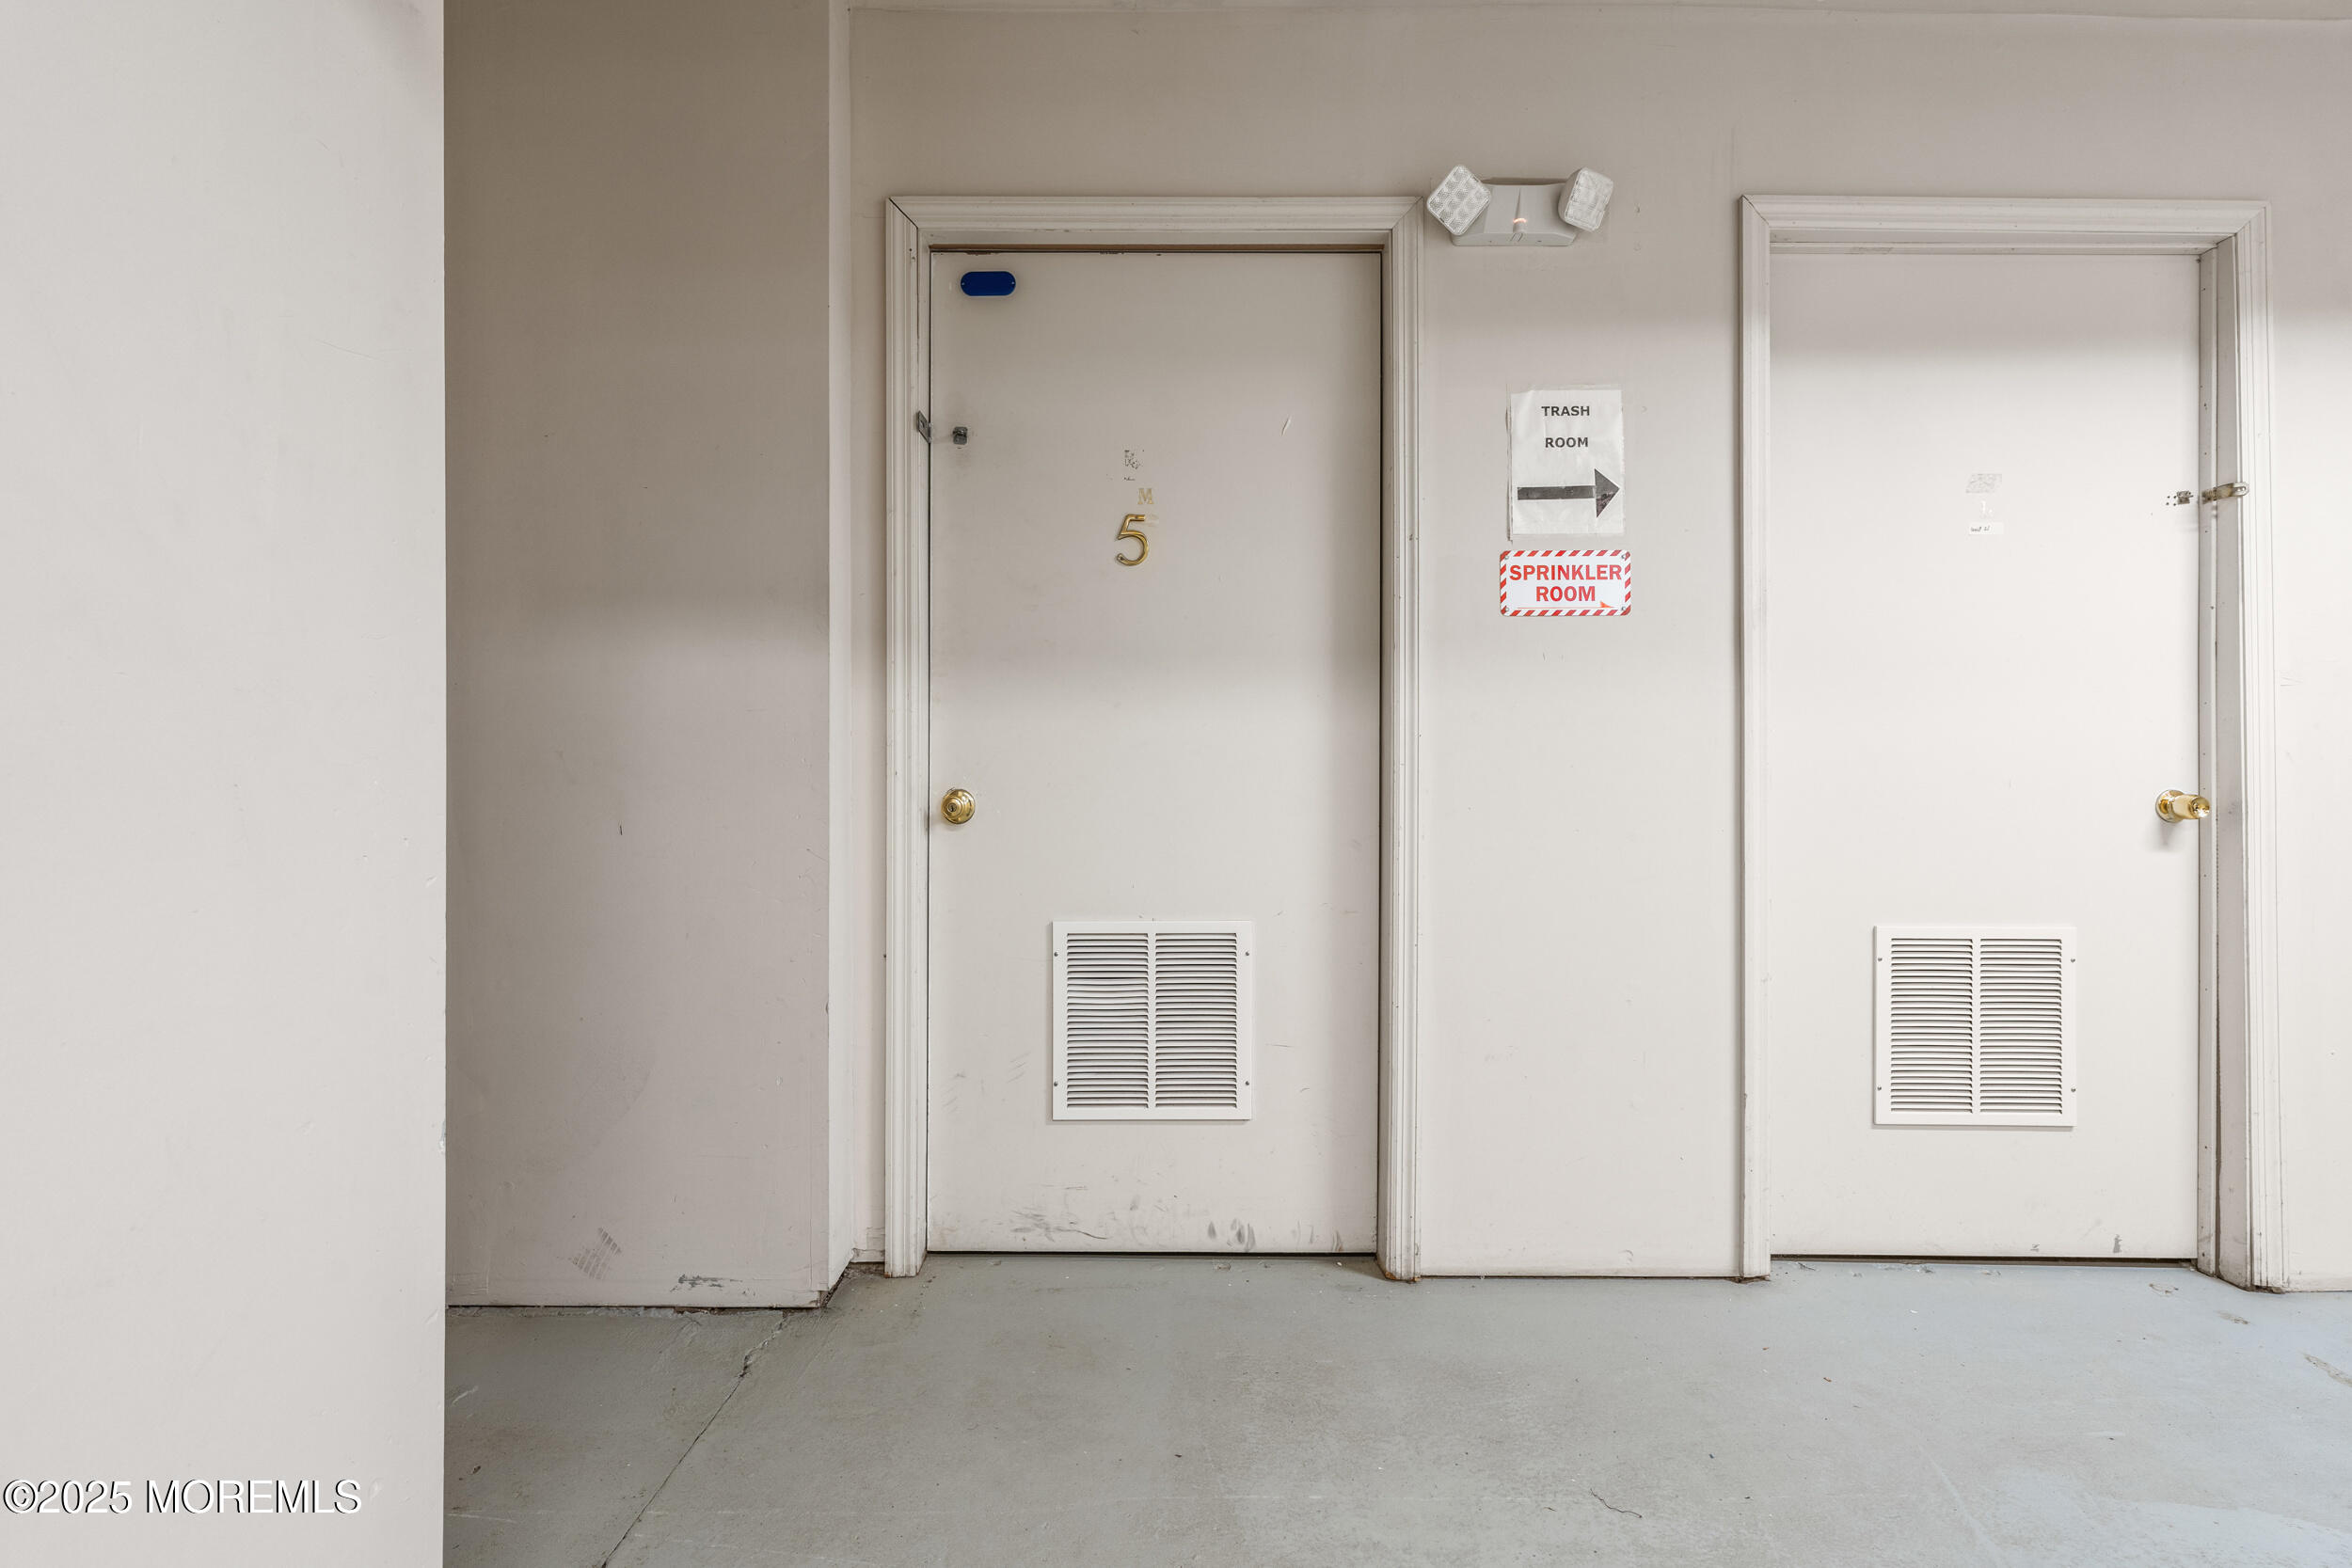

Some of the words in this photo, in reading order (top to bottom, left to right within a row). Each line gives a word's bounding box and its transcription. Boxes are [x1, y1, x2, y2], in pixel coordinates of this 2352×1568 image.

[1541, 405, 1590, 417] TRASH
[1545, 436, 1589, 448] ROOM
[1137, 487, 1154, 505] M
[1116, 514, 1149, 566] 5
[1509, 564, 1622, 580] SPRINKLER
[1535, 585, 1596, 602] ROOM
